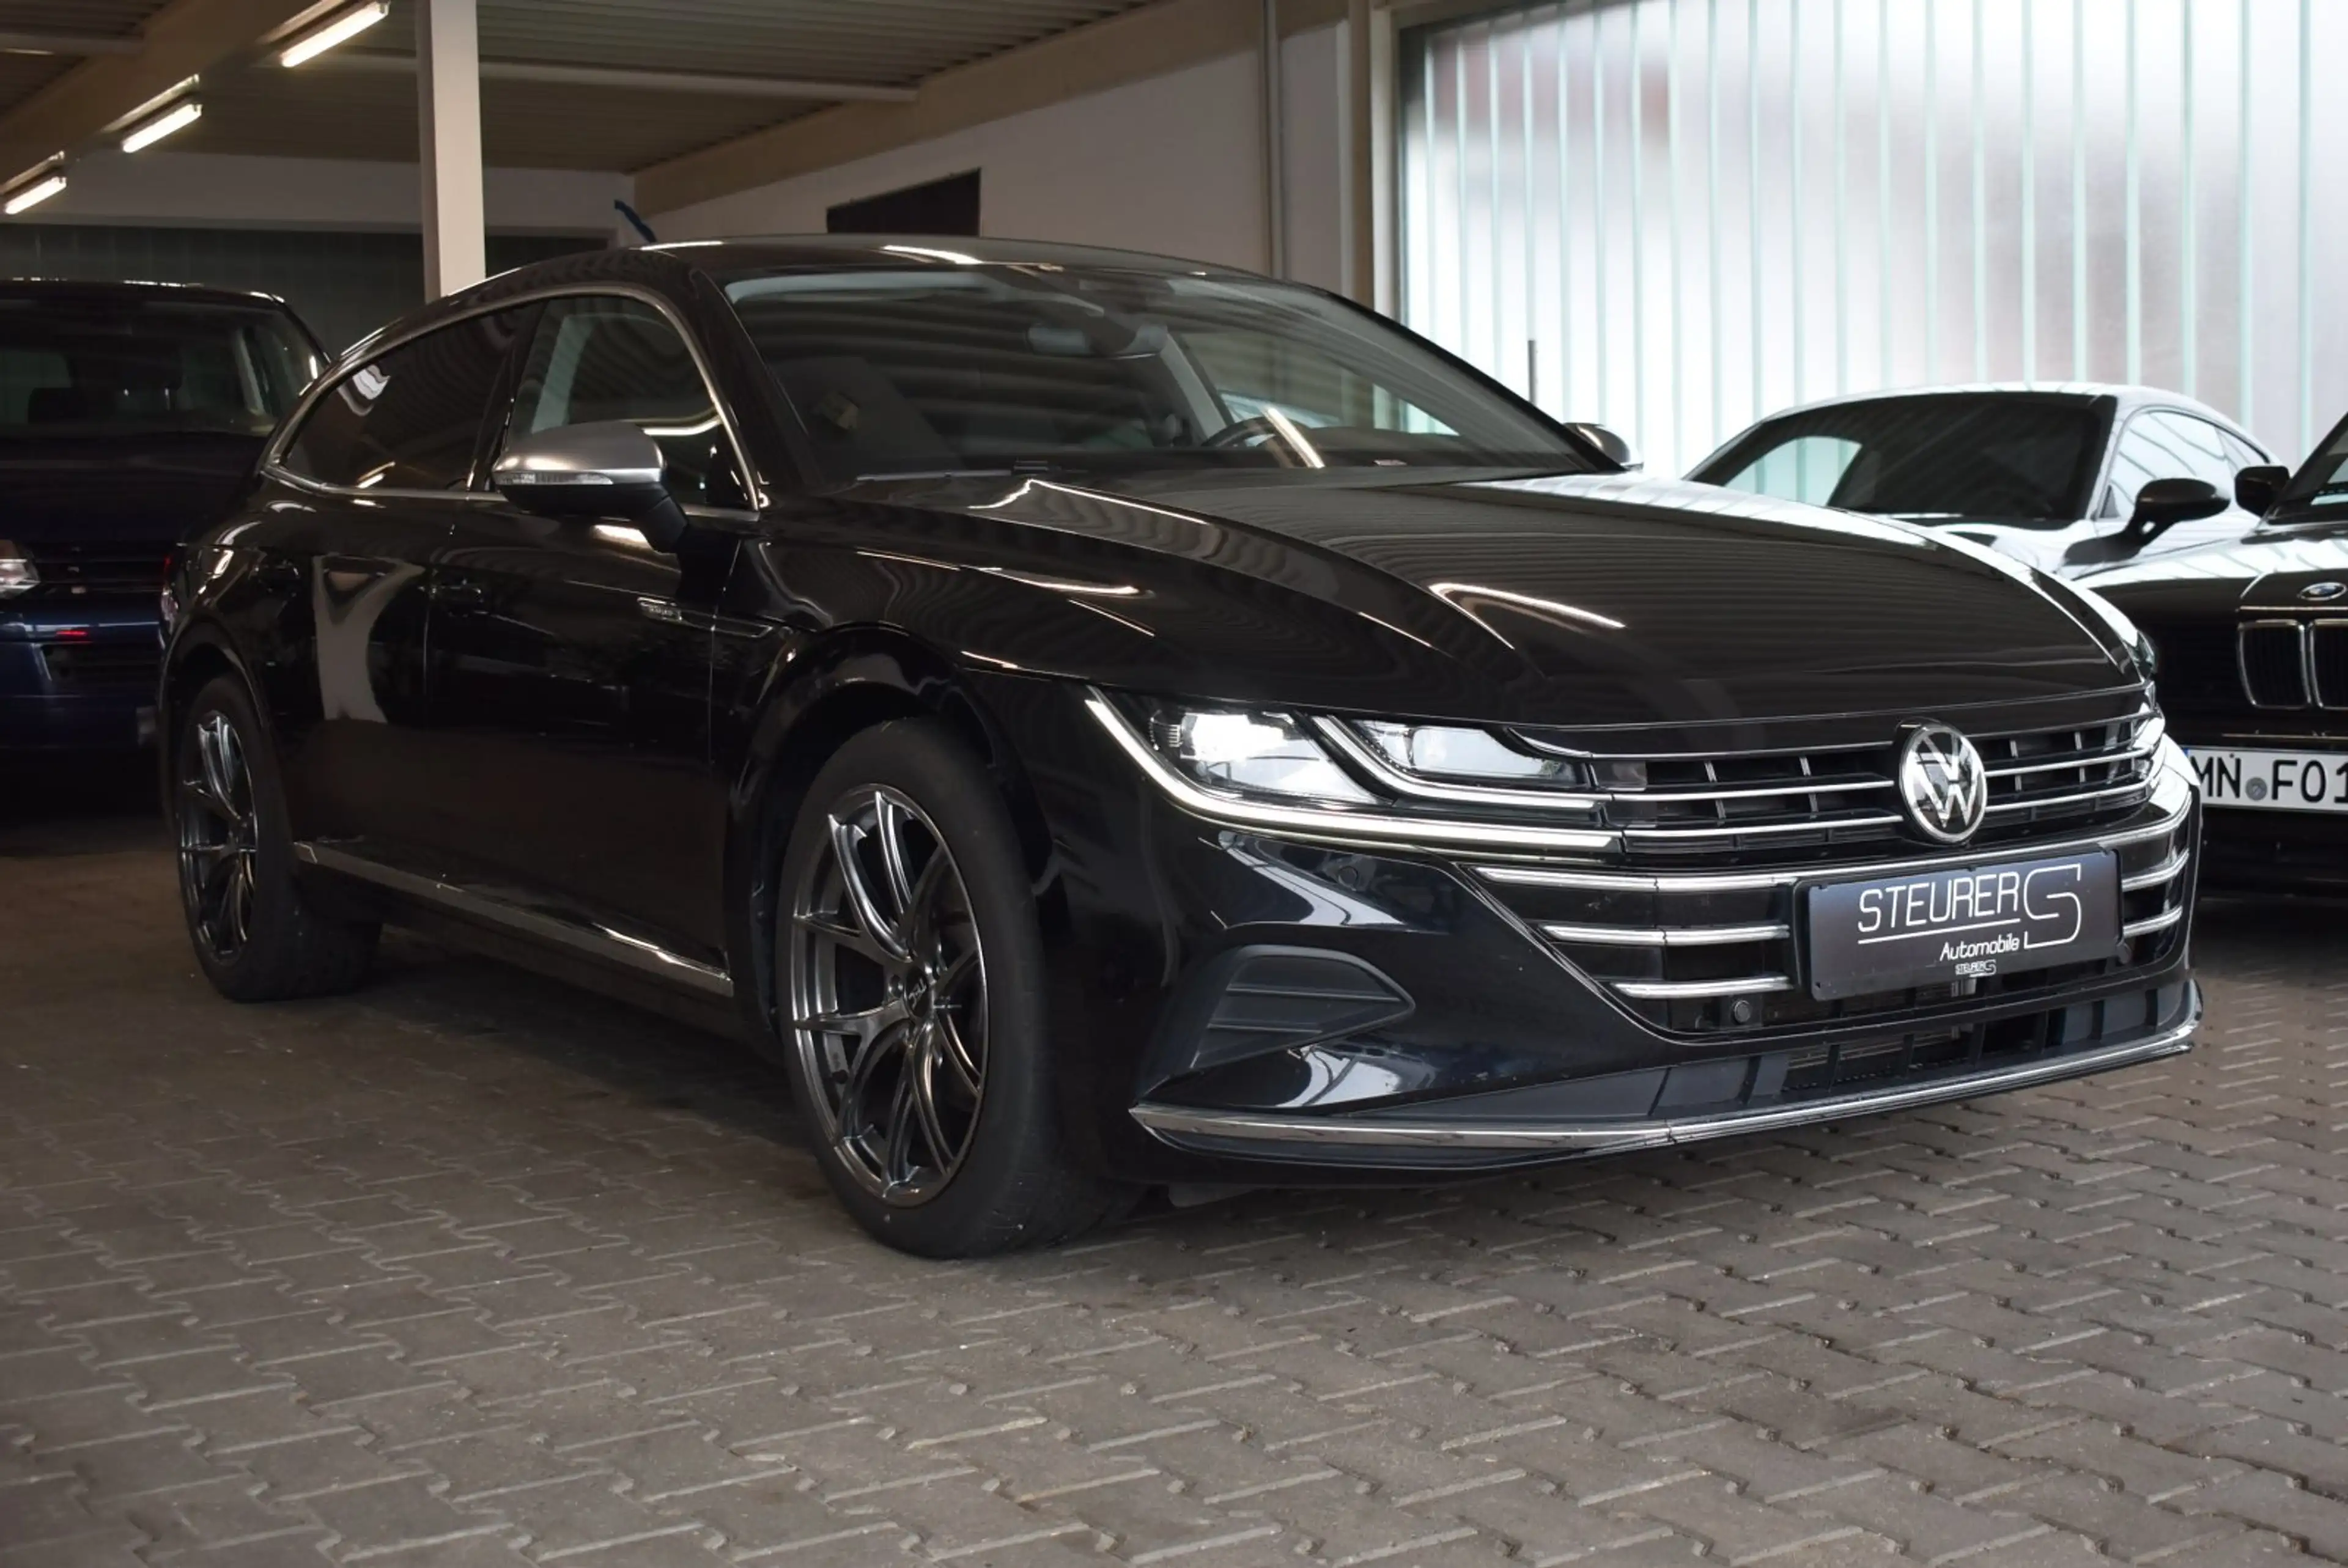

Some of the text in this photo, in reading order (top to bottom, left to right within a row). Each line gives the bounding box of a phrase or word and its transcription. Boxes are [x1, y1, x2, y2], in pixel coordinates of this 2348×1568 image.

[2190, 755, 2242, 799] MN
[1858, 871, 2020, 933] STEURER
[1940, 932, 2020, 962] Automobile
